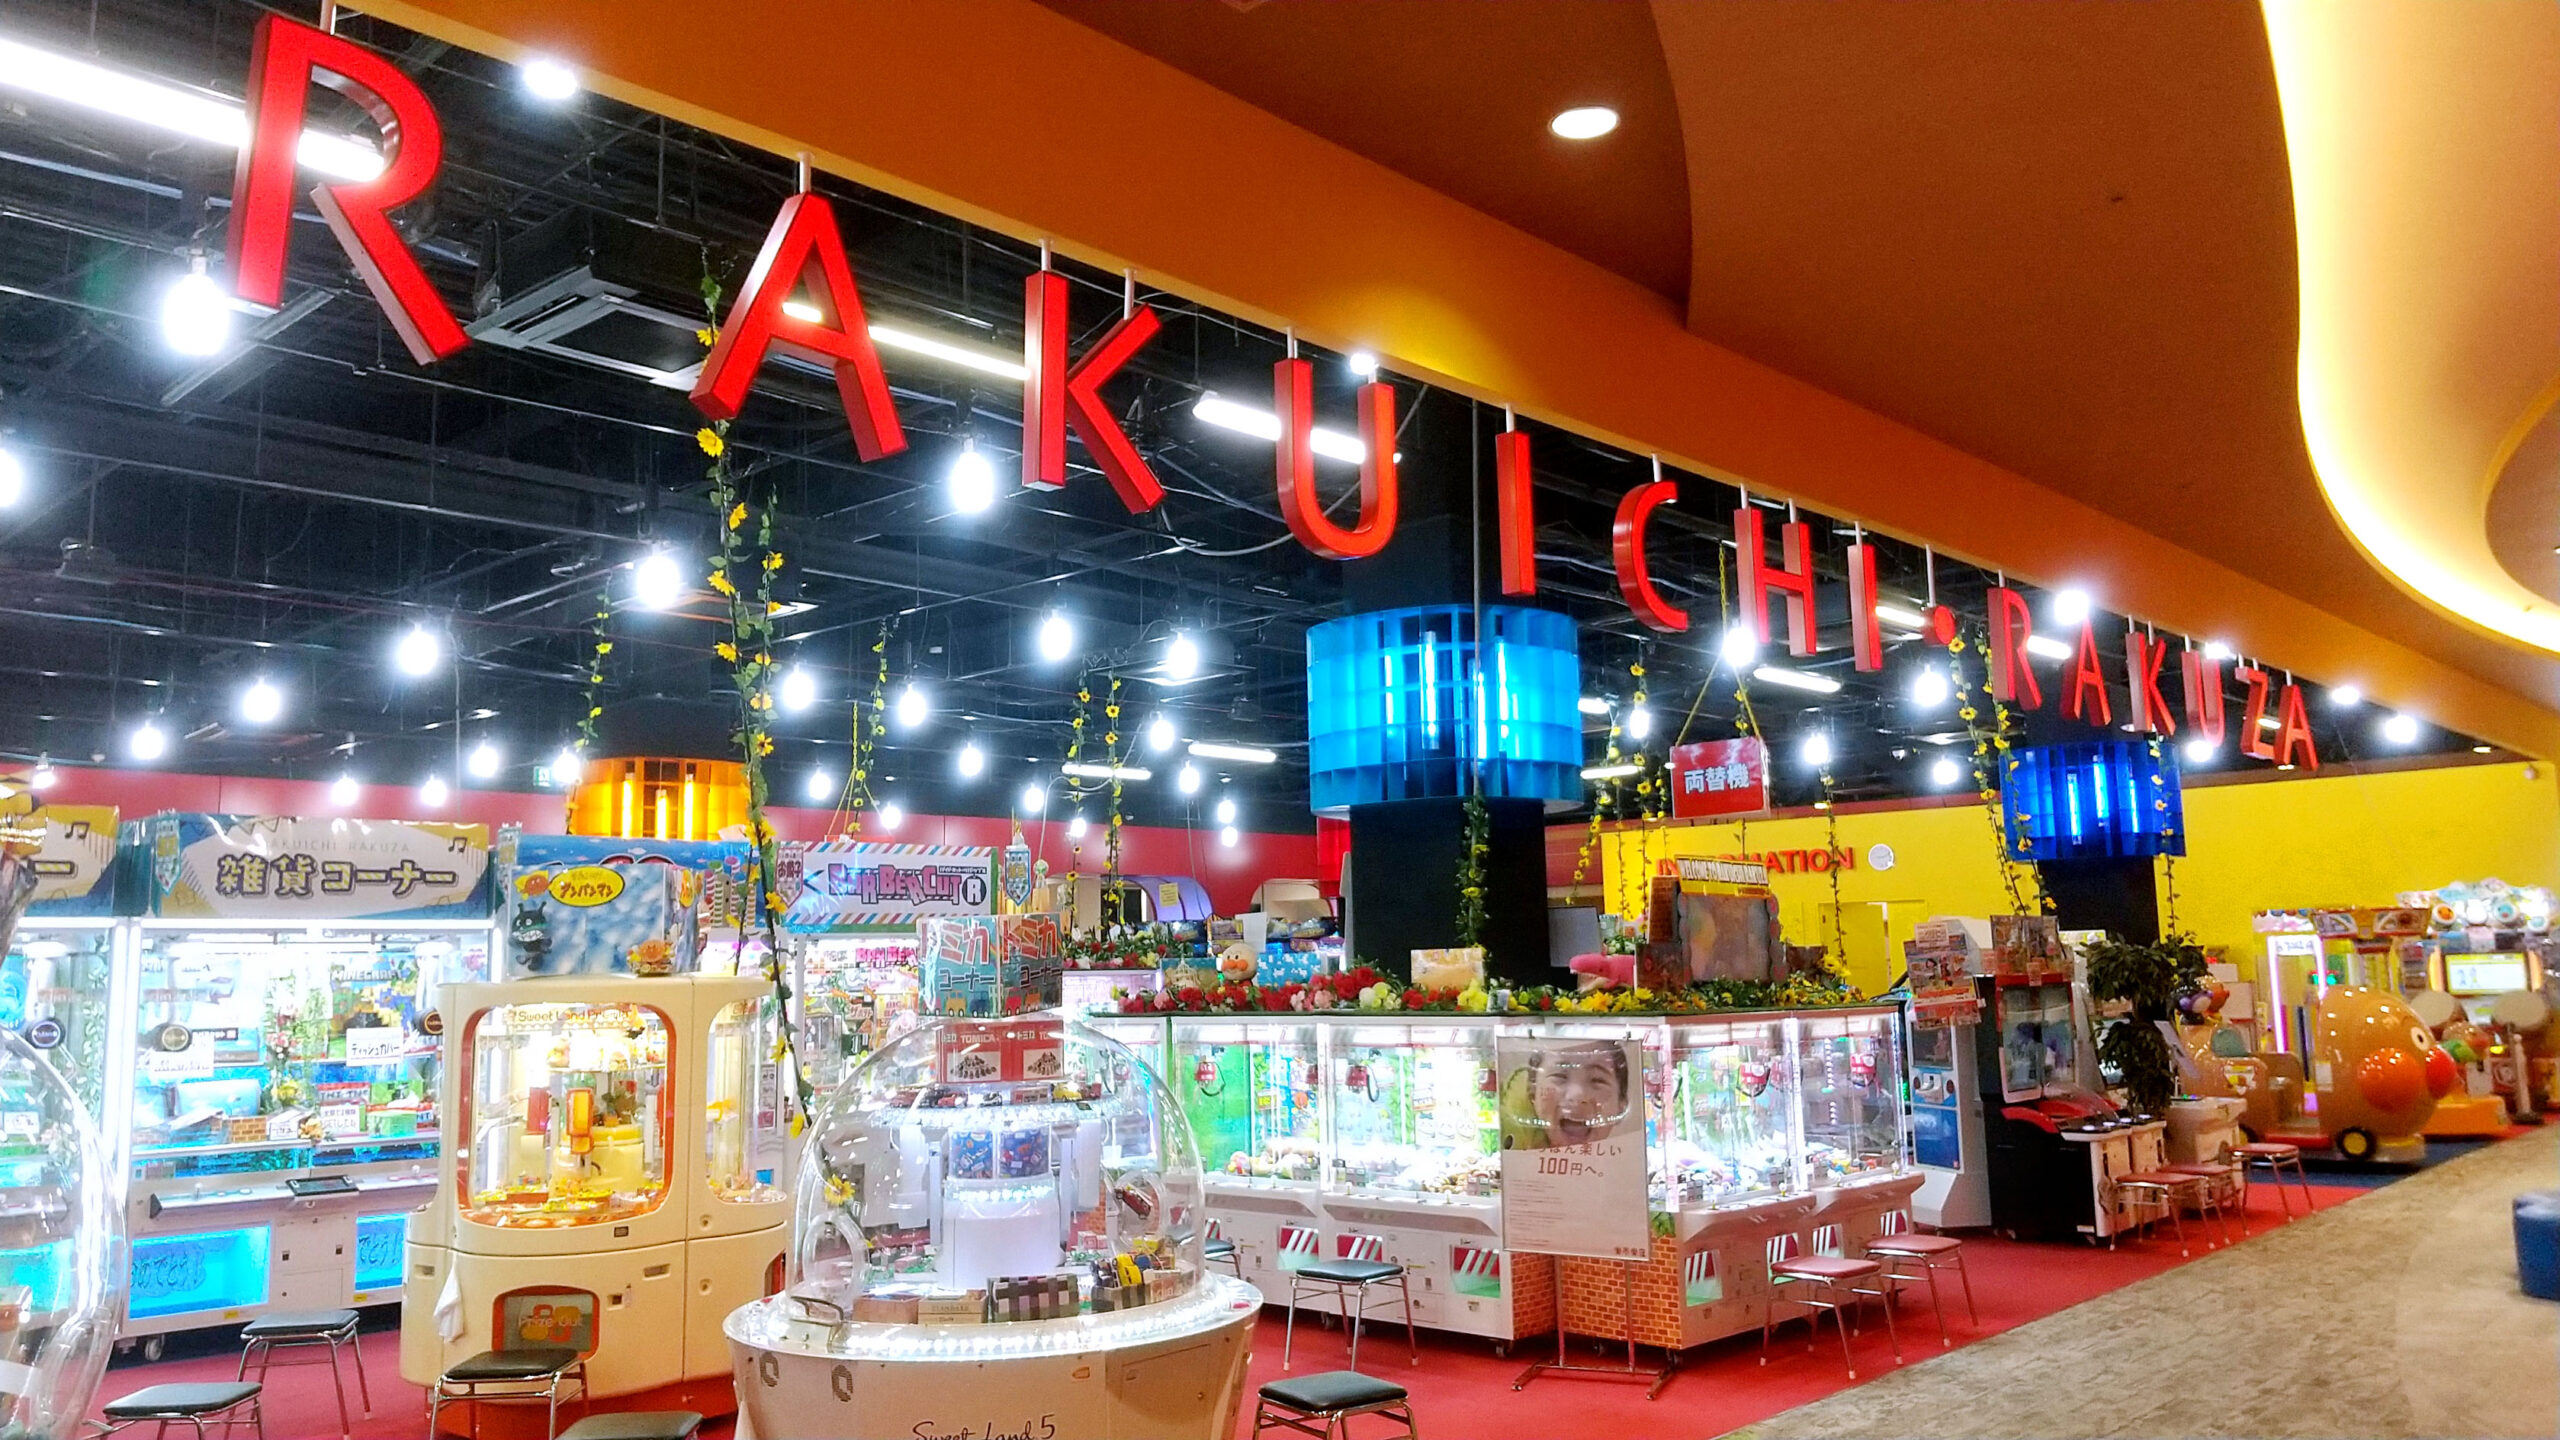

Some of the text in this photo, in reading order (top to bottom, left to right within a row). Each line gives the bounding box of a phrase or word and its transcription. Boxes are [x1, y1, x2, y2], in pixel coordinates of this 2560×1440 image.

[1684, 762, 1750, 795] 両替機
[217, 853, 460, 900] 雑貨コーナー
[560, 881, 614, 899] アンパンマン
[1002, 916, 1058, 963] トミカ
[331, 969, 402, 982] MINECRAFT
[938, 967, 996, 991] コーナー
[1019, 962, 1063, 988] コーナー
[960, 1033, 997, 1043] TOMICA
[351, 1043, 401, 1057] ティッシュカバー
[1537, 1156, 1605, 1178] 100円へ。
[518, 1315, 583, 1328] Prize Out
[1039, 1413, 1056, 1440] 5
